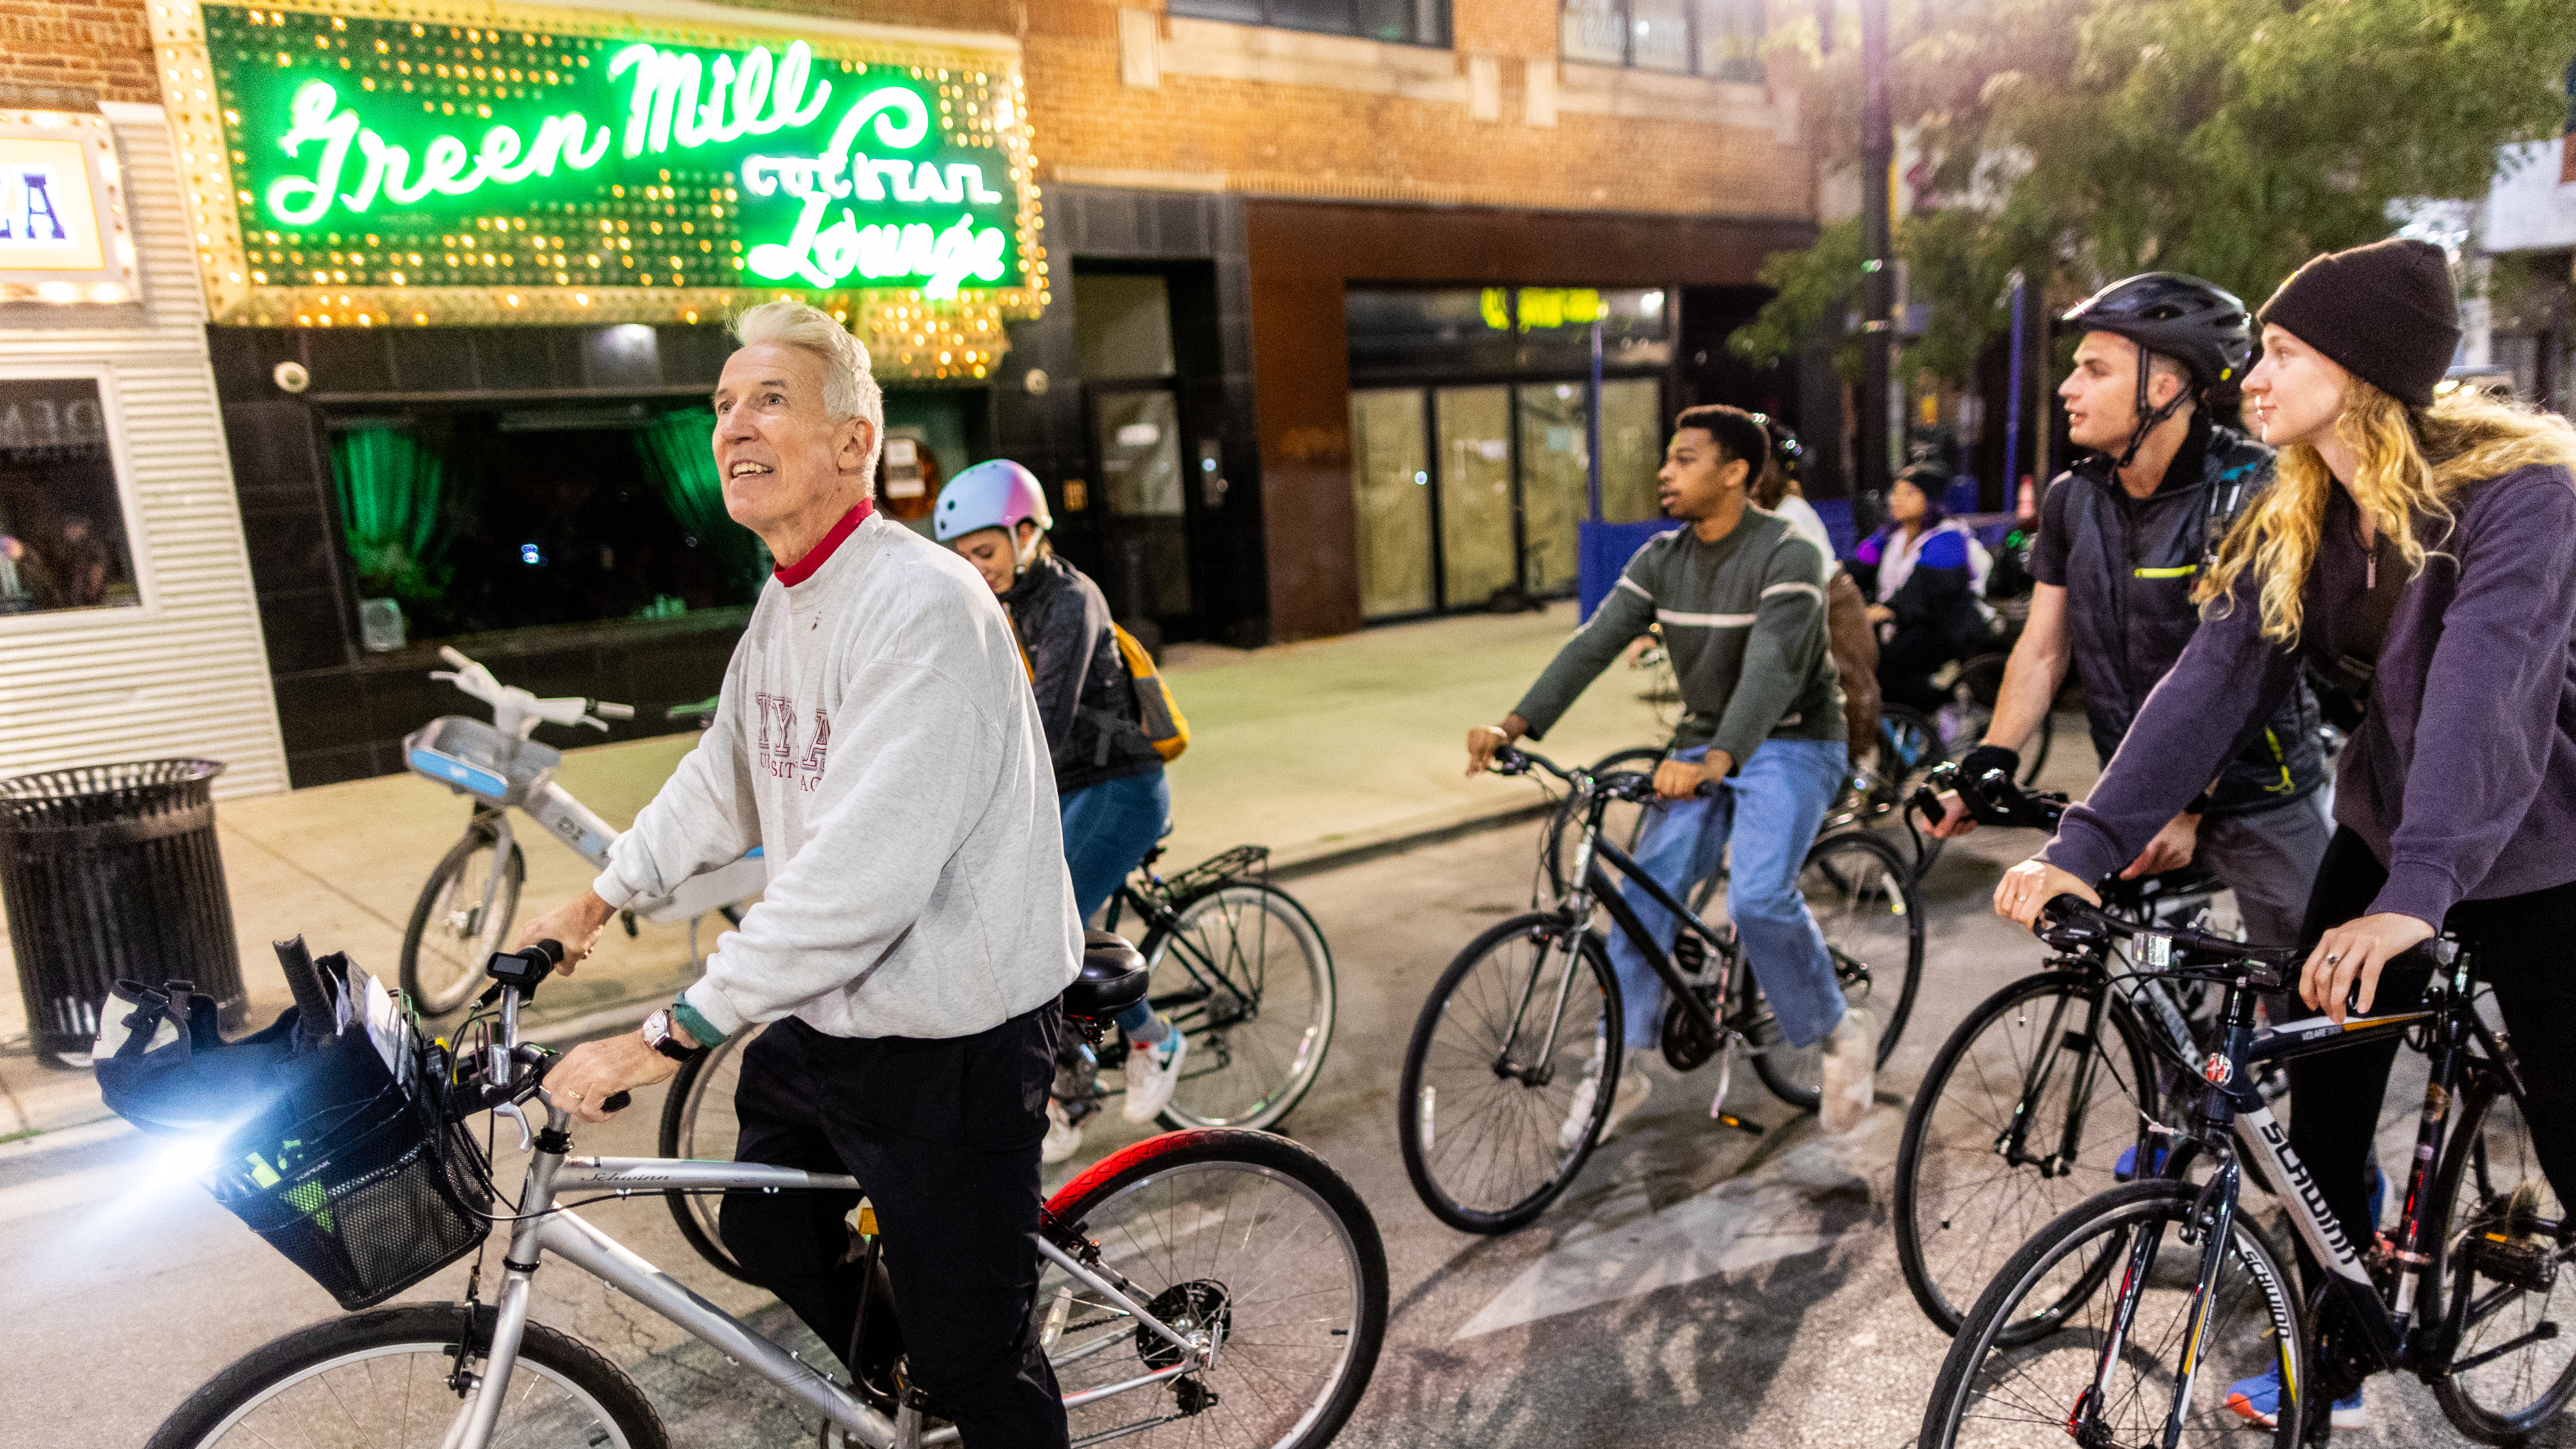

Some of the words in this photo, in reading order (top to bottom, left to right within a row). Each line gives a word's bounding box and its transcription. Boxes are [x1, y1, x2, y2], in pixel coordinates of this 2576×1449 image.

[267, 81, 611, 226] Green
[607, 39, 833, 158] Mill
[746, 173, 1006, 302] Lounge
[581, 1172, 670, 1181] Schwinn
[2243, 1250, 2291, 1339] SCHWINN
